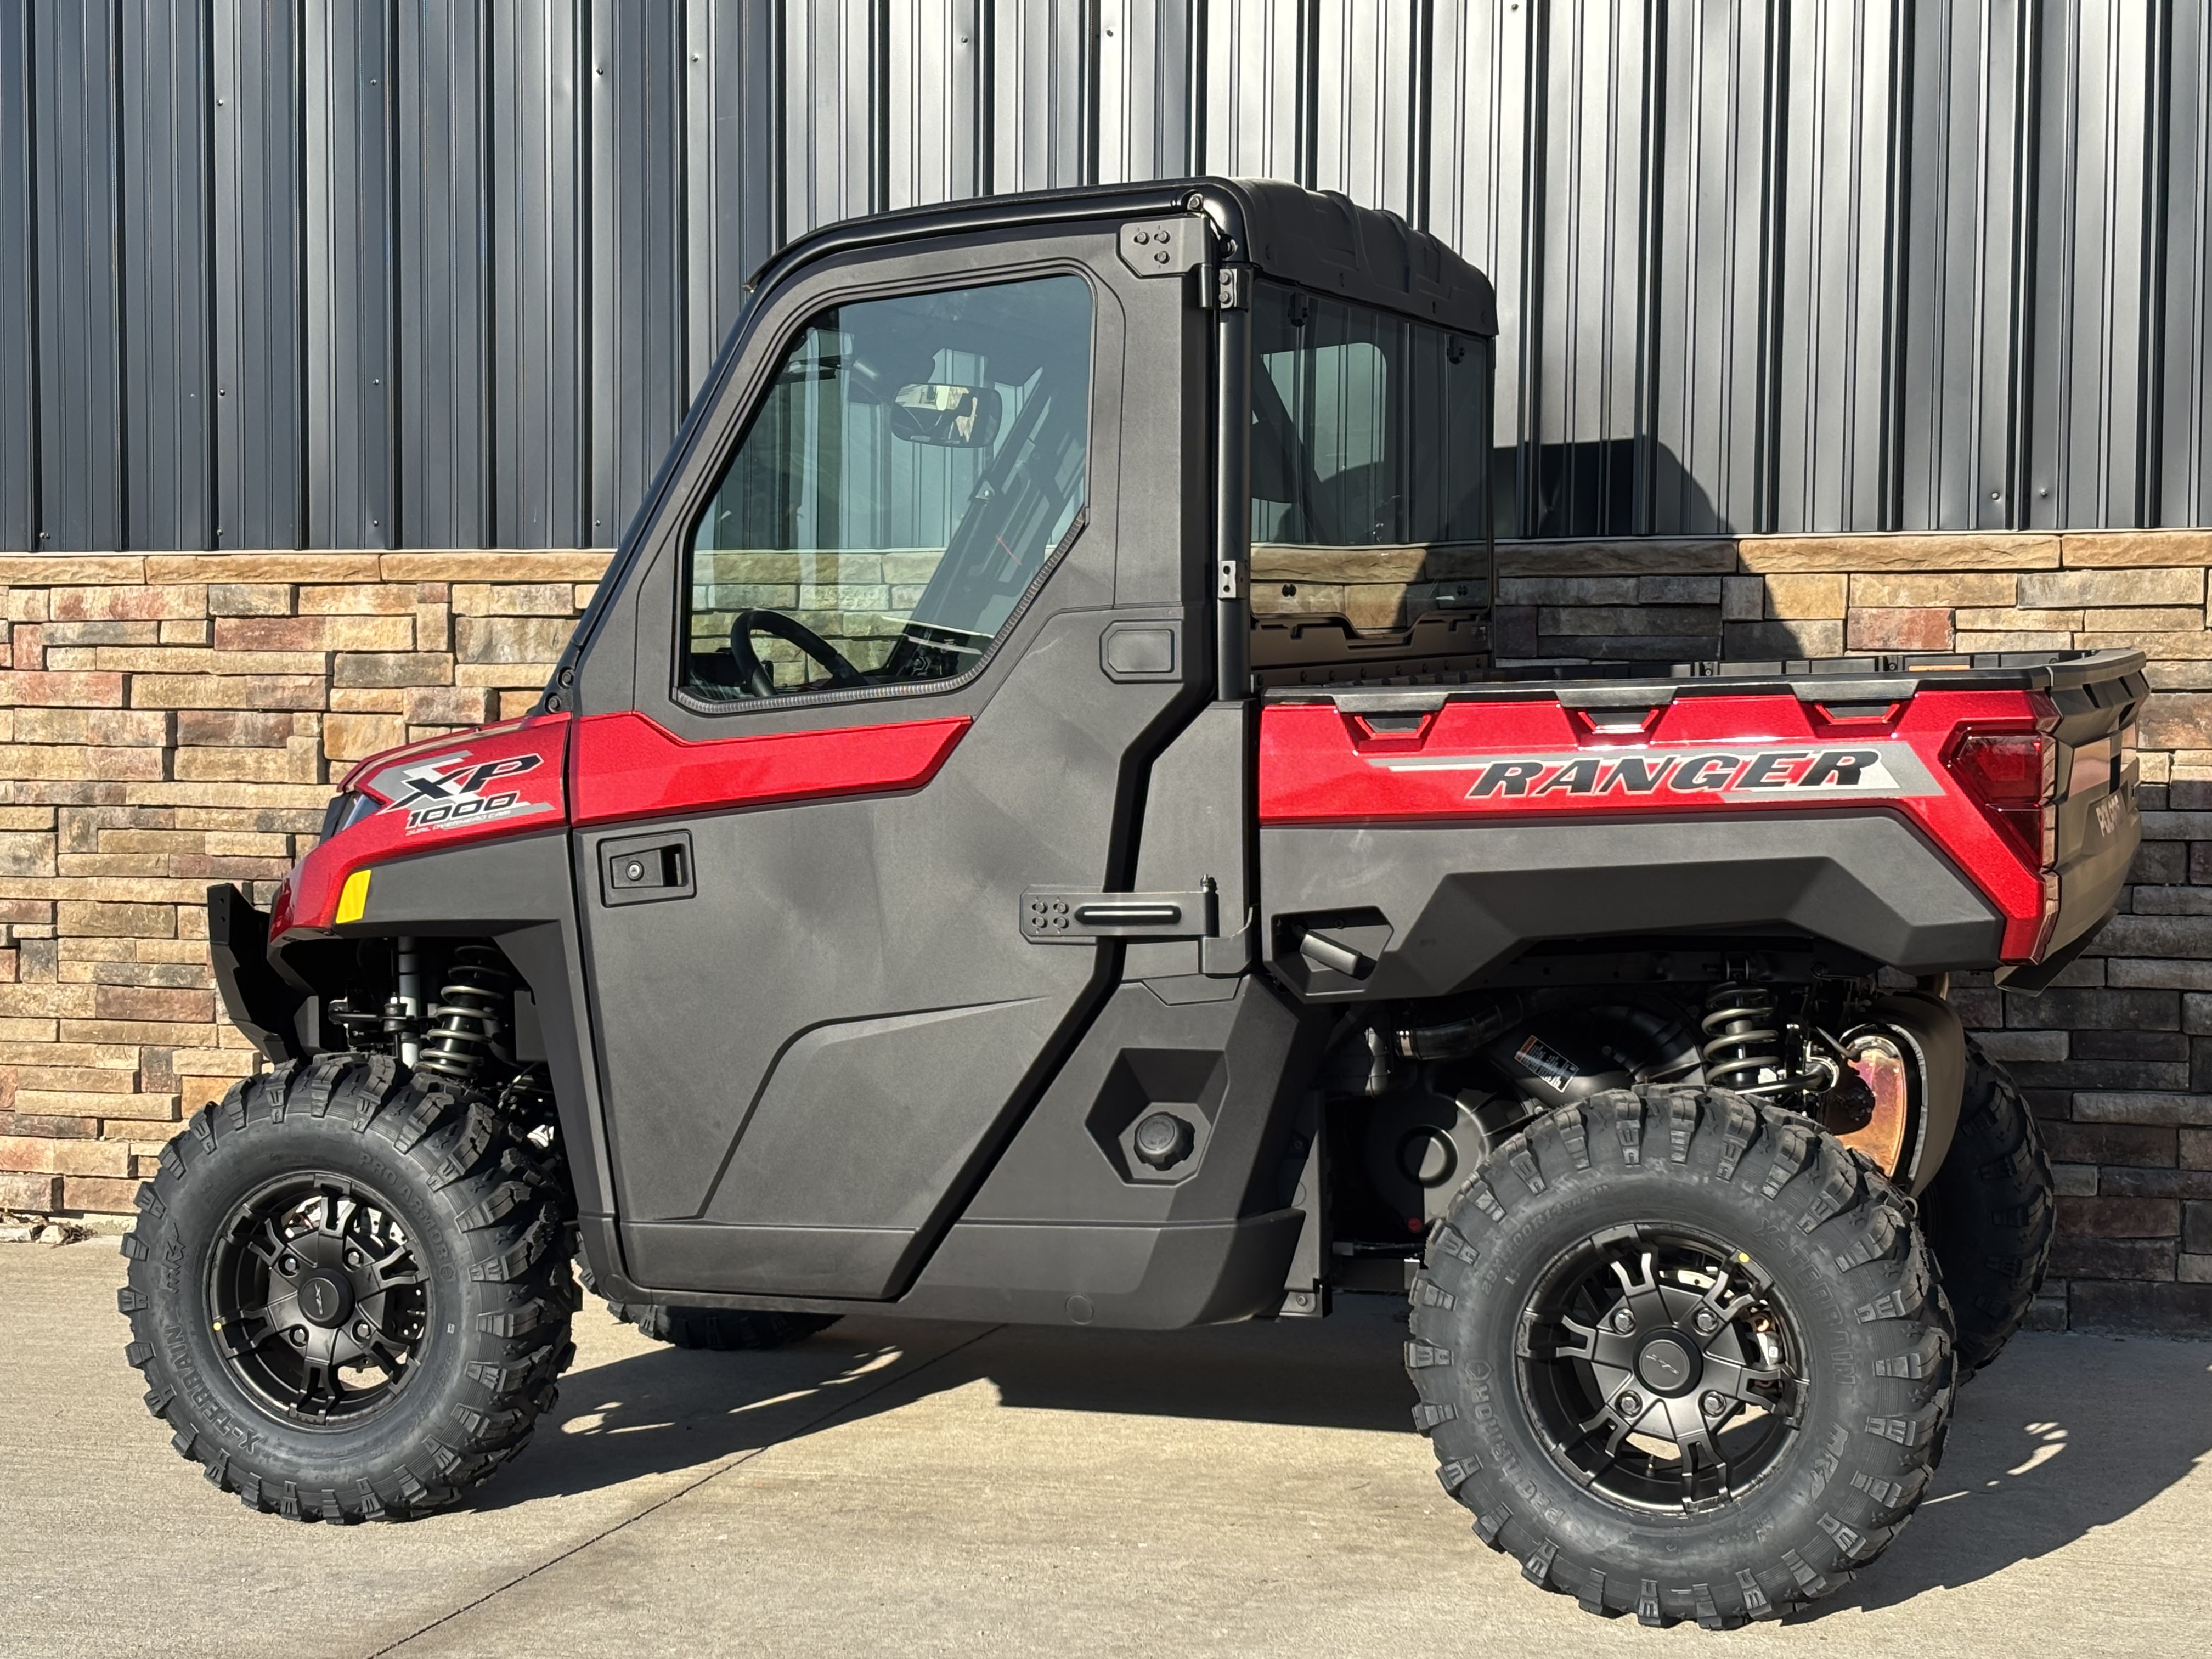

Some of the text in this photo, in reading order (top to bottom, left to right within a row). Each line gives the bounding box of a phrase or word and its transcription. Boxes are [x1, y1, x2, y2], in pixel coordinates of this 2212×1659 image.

[377, 753, 544, 816] XP
[405, 791, 521, 829] 1000
[1465, 748, 1883, 799] RANGER
[405, 827, 431, 837] DUAL
[488, 810, 511, 819] CAM
[358, 1153, 449, 1261] PRO ARMOR
[1754, 1216, 1856, 1385] X-TERRAIN
[165, 1325, 263, 1454] X-TERRAIN
[1472, 1384, 1565, 1525] PRO ARMOR
